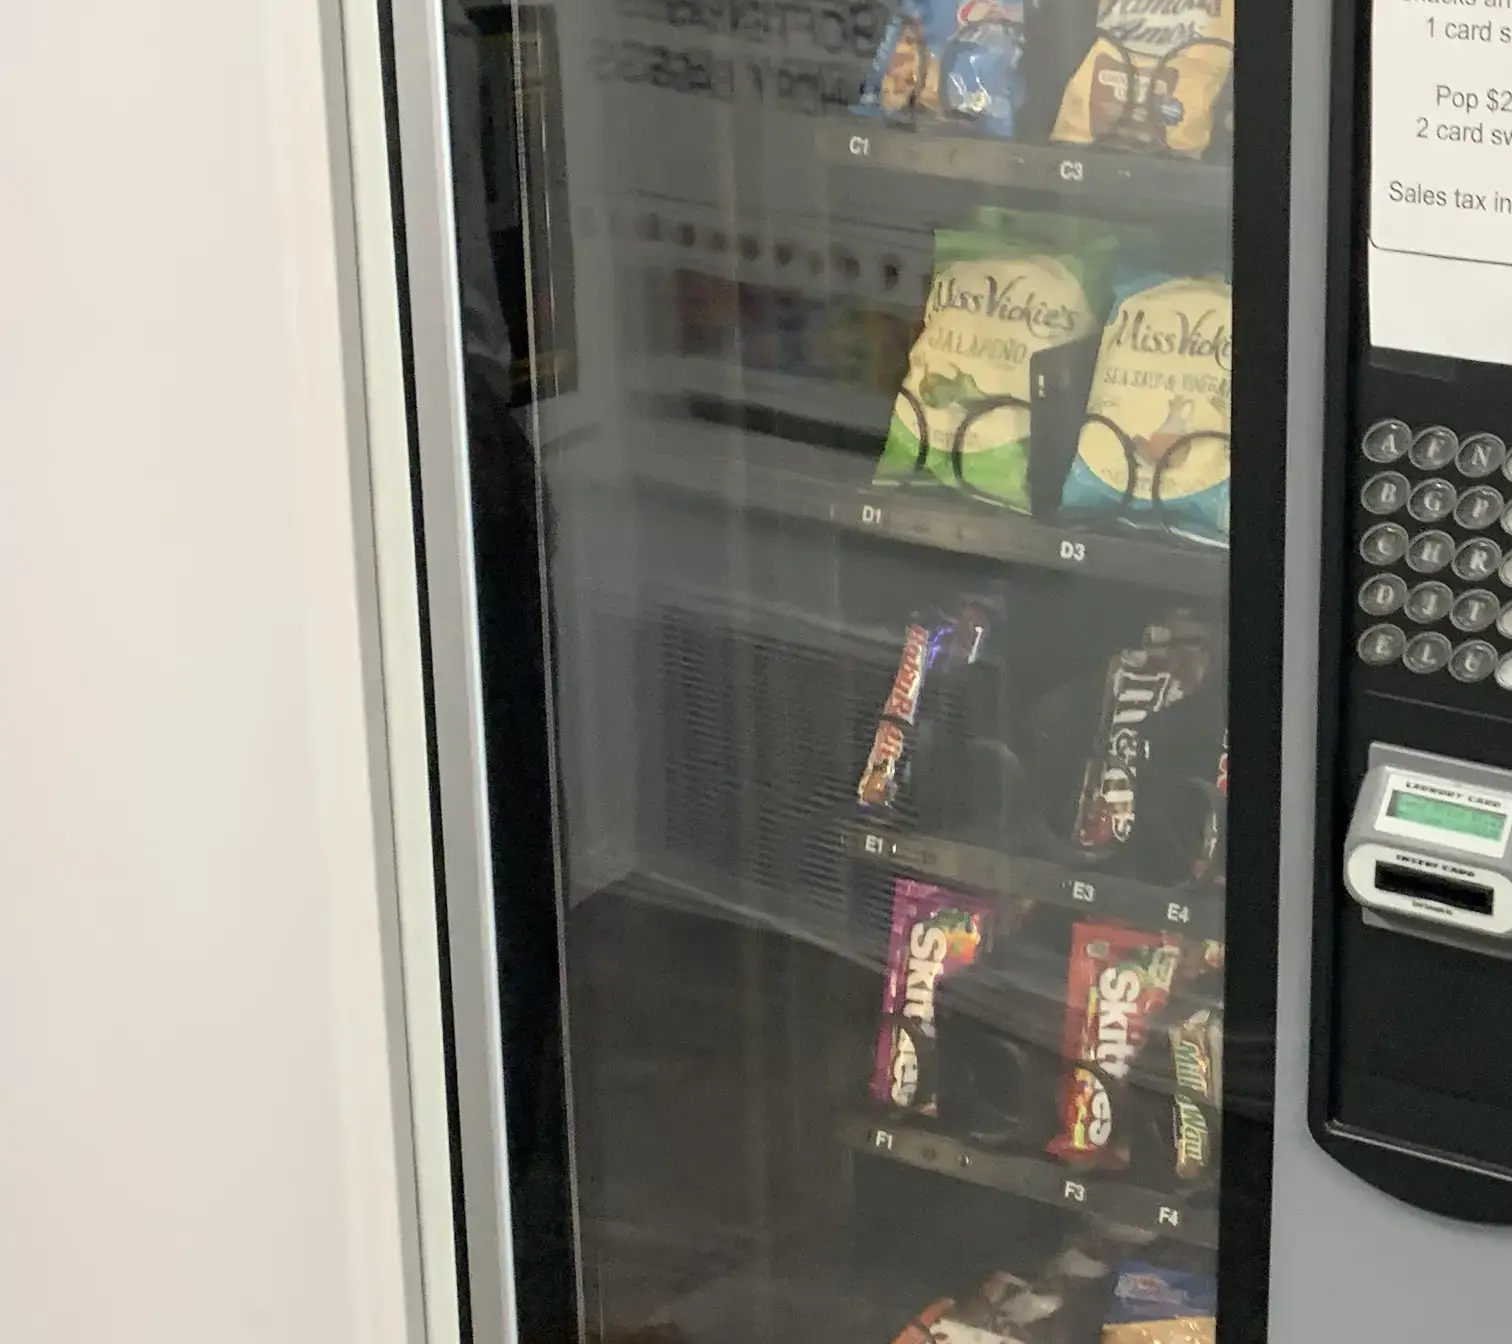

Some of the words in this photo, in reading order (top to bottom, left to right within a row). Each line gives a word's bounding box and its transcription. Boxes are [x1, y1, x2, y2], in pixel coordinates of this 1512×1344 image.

[1426, 16, 1435, 38] 1
[1445, 20, 1492, 42] card
[1436, 84, 1479, 114] Pop
[1416, 117, 1429, 139] 2
[1436, 123, 1484, 144] card
[847, 135, 870, 156] C1
[1058, 160, 1084, 182] C3
[1388, 181, 1448, 207] Sales
[1454, 189, 1487, 212] tax
[1381, 483, 1397, 503] B
[861, 504, 882, 524] D1
[1059, 539, 1087, 561] D3
[863, 834, 884, 854] E1
[1072, 881, 1096, 902] E3
[1166, 902, 1190, 924] E4
[1088, 966, 1141, 1148] Skittes
[875, 1131, 893, 1151] F1
[1064, 1181, 1086, 1202] F3
[1158, 1205, 1180, 1227] F4
